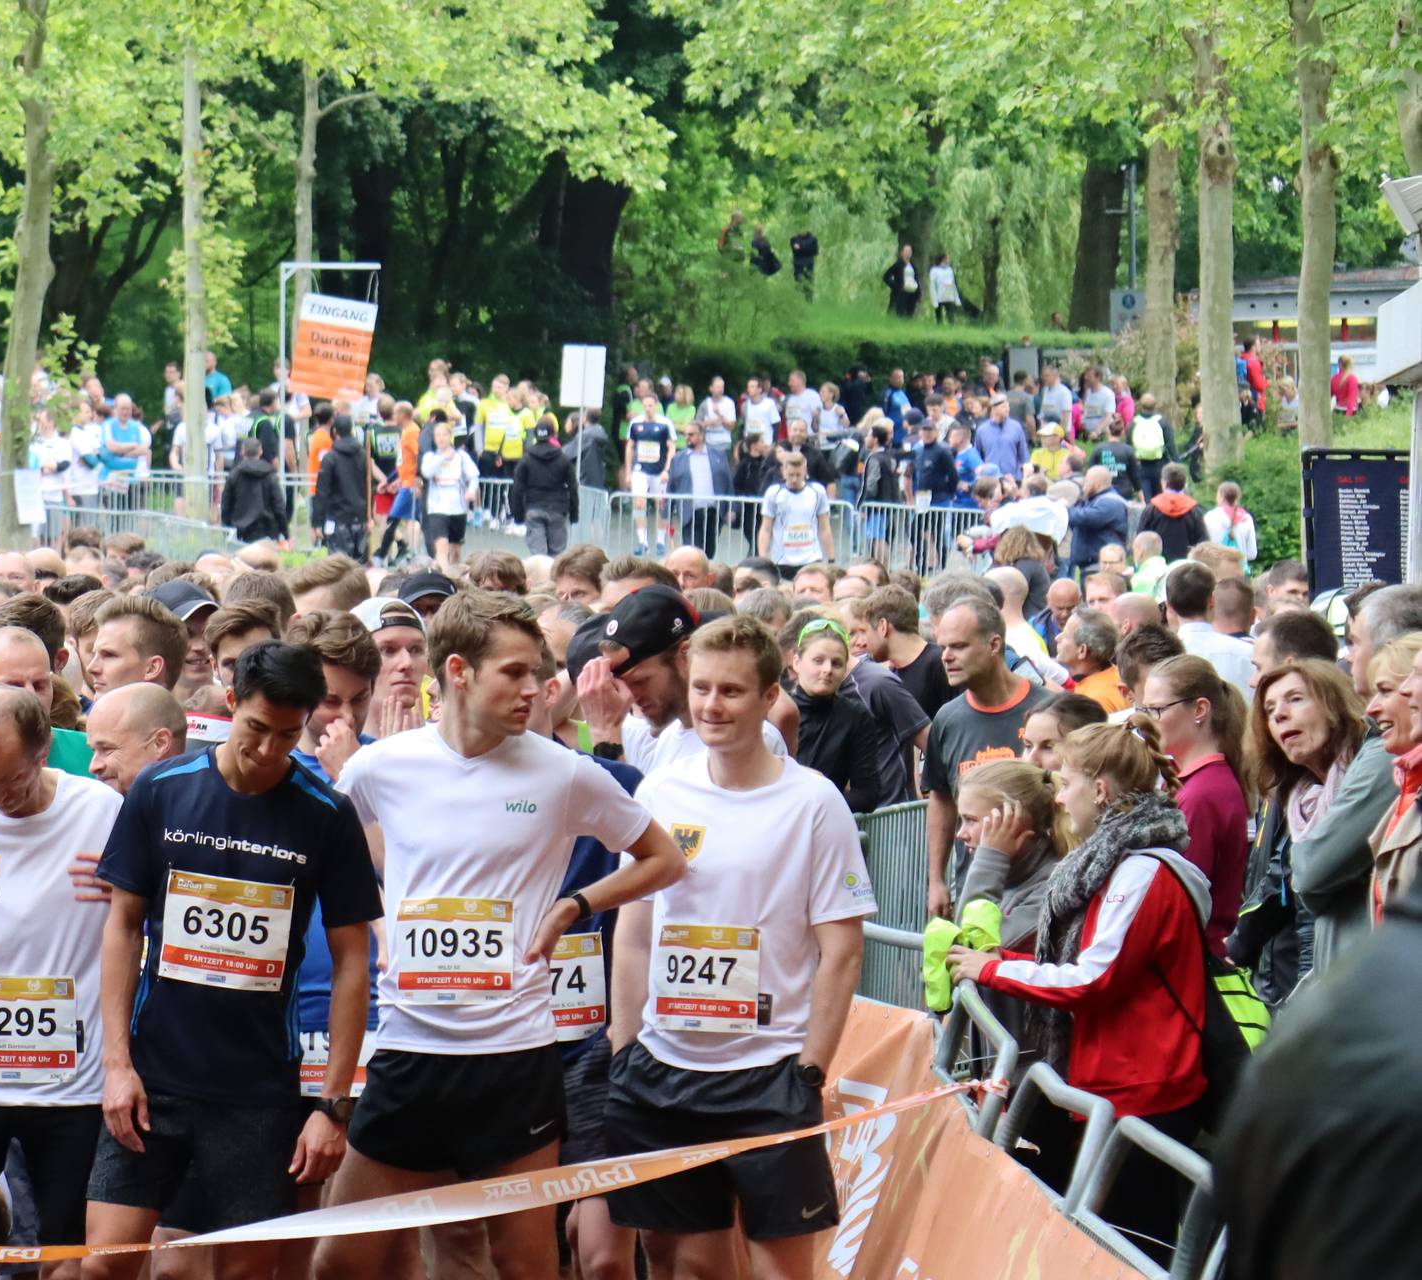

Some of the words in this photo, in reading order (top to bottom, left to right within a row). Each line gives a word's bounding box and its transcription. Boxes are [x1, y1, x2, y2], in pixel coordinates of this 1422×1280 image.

[309, 303, 368, 323] EINGANG
[310, 331, 357, 348] Durch-
[506, 800, 537, 813] wilo
[164, 828, 307, 864] körlinginteriors
[183, 905, 270, 945] 6305
[405, 928, 503, 958] 10935
[184, 953, 224, 966] STARTZEIT
[245, 963, 258, 971] Uhr
[266, 964, 275, 973] D
[666, 954, 738, 986] 9247
[417, 976, 451, 984] STARTZEIT
[494, 975, 503, 986] D
[590, 1009, 599, 1020] D
[739, 1004, 748, 1014] D
[59, 1053, 68, 1064] D
